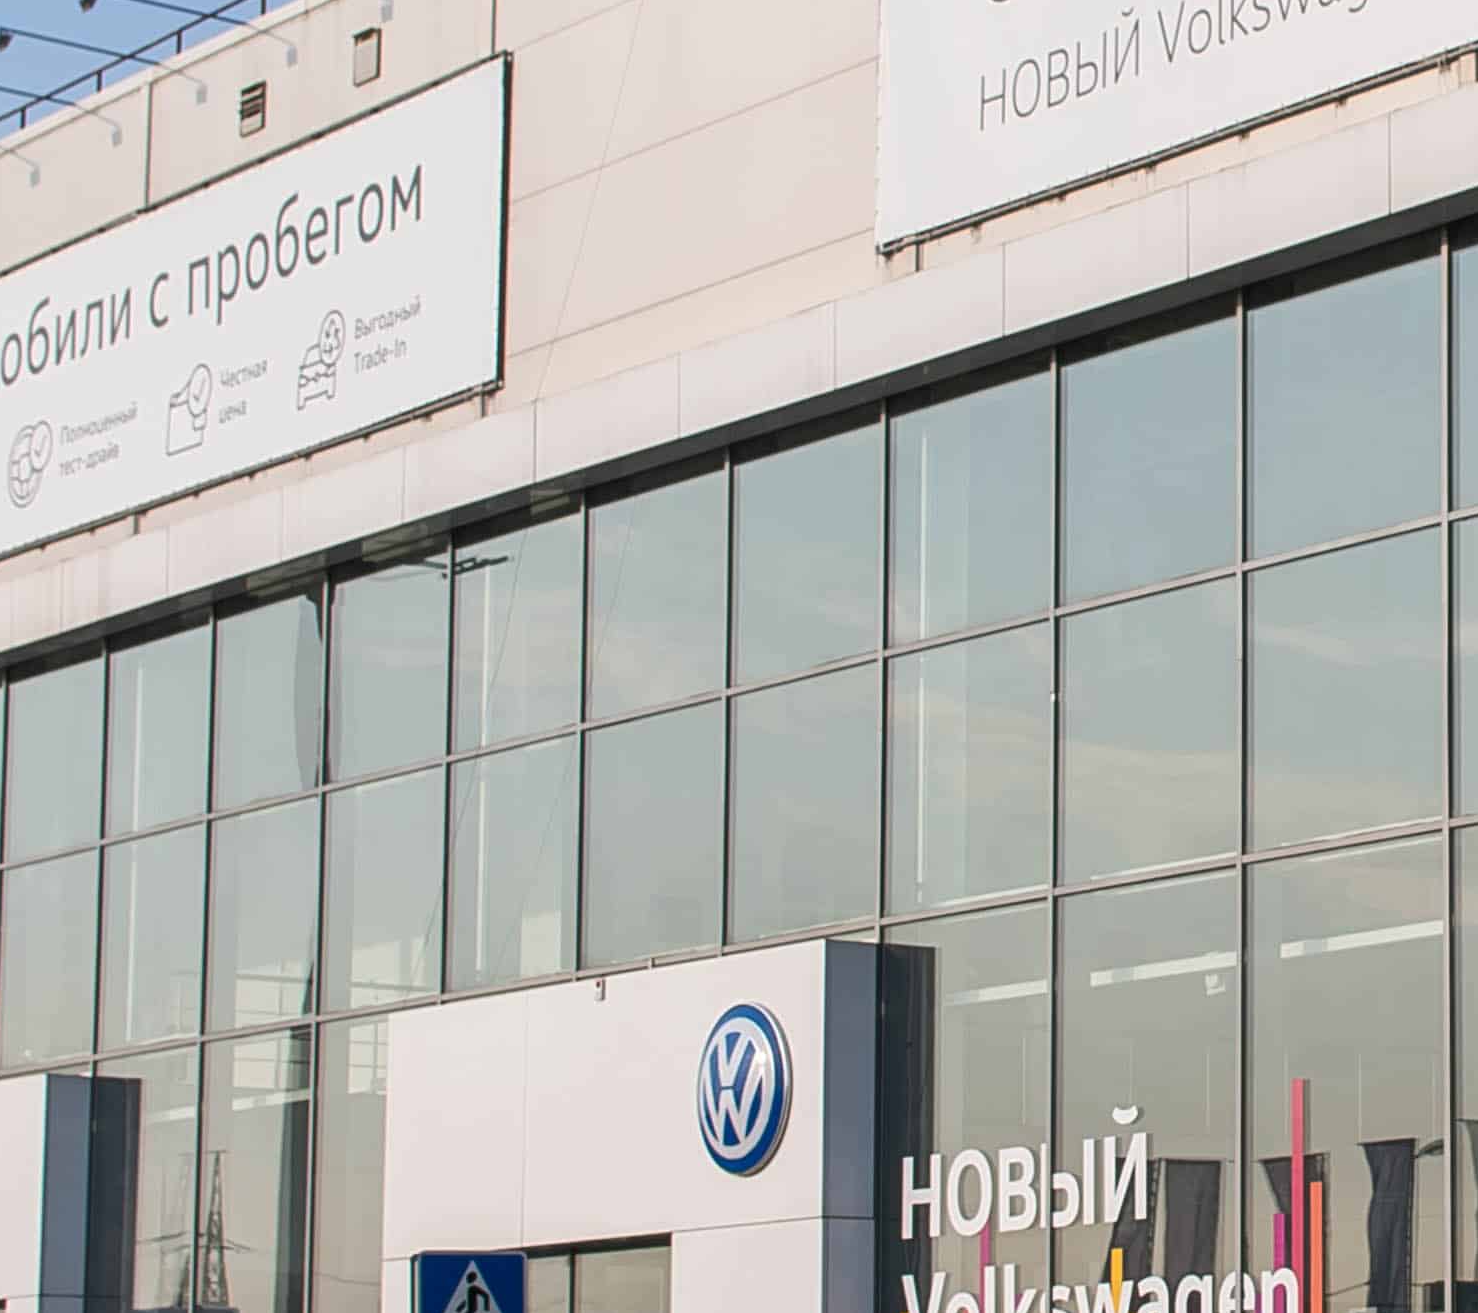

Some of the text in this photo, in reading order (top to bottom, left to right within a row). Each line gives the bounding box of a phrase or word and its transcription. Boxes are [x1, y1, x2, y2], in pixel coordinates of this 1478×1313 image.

[150, 273, 170, 327] с
[188, 165, 423, 325] пробегом
[354, 294, 421, 339] Выгодный
[221, 359, 268, 389] Честная
[353, 337, 408, 374] Trade-In
[59, 401, 138, 445] Полноценный
[901, 1104, 1149, 1240] НОВЫЙ
